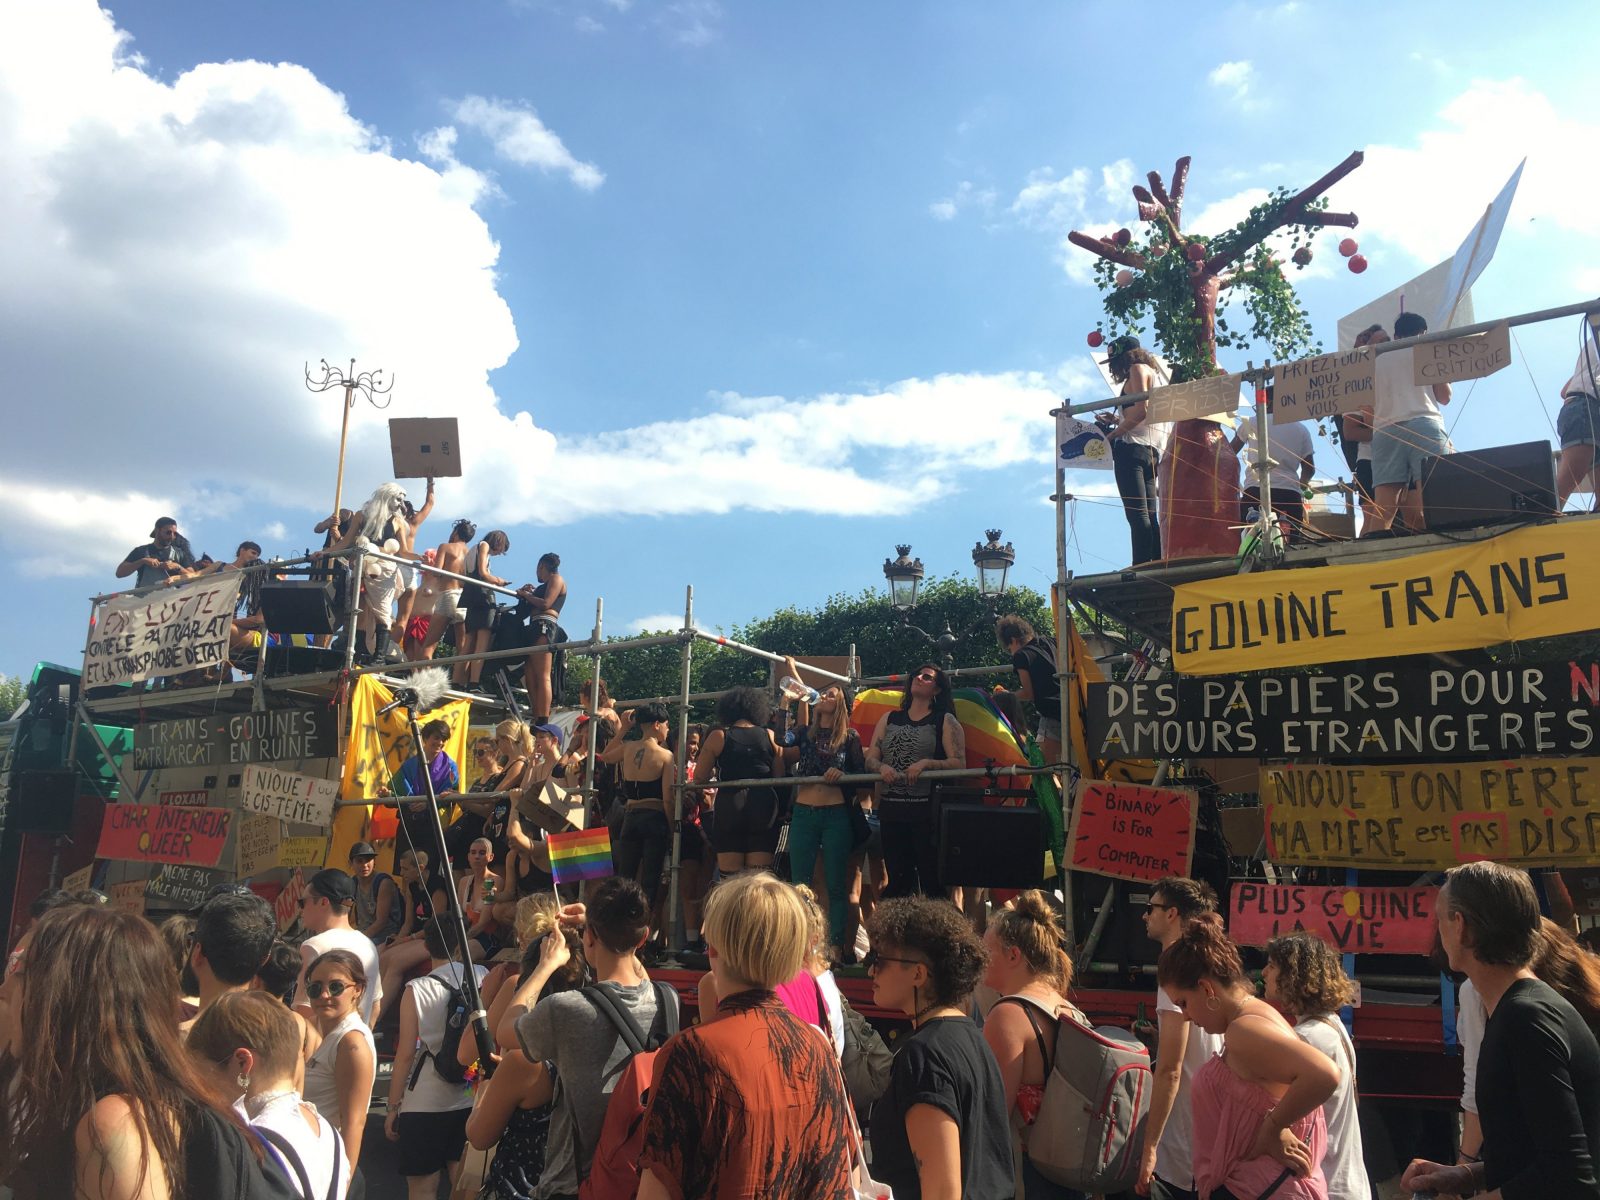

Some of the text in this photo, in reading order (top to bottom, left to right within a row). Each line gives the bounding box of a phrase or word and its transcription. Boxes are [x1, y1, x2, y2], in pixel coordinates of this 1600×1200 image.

[1421, 347, 1504, 378] CRITIQUE
[1433, 341, 1489, 360] EROS
[1281, 376, 1373, 407] ON BAISE POUR
[1309, 371, 1341, 389] NOUS
[1152, 392, 1234, 420] PRIDE
[1307, 398, 1339, 416] VOUS
[145, 590, 220, 627] LUTTE
[1176, 552, 1569, 655] GOUINE TRANS
[87, 663, 99, 683] ET
[1107, 683, 1177, 718] DES
[1203, 672, 1400, 721] PAPIERS
[1430, 669, 1547, 706] POUR
[149, 718, 208, 743] TRANS
[229, 710, 317, 740] GOUINES
[1100, 709, 1594, 754] AMOURS ETRANGERES
[135, 735, 318, 768] PATRIARCAT EN RUINE
[169, 792, 207, 806] LOXAM
[1380, 769, 1463, 812] TON
[111, 804, 231, 838] CHAR INTERIEUR
[1415, 824, 1452, 843] est
[1460, 822, 1499, 849] PAS
[138, 831, 193, 857] QUEER
[1098, 843, 1170, 872] COMPUTER
[192, 870, 212, 887] PAS
[181, 887, 206, 905] FEMEL
[1238, 884, 1429, 920] PLUS GOUINE
[1328, 918, 1385, 949] VIE
